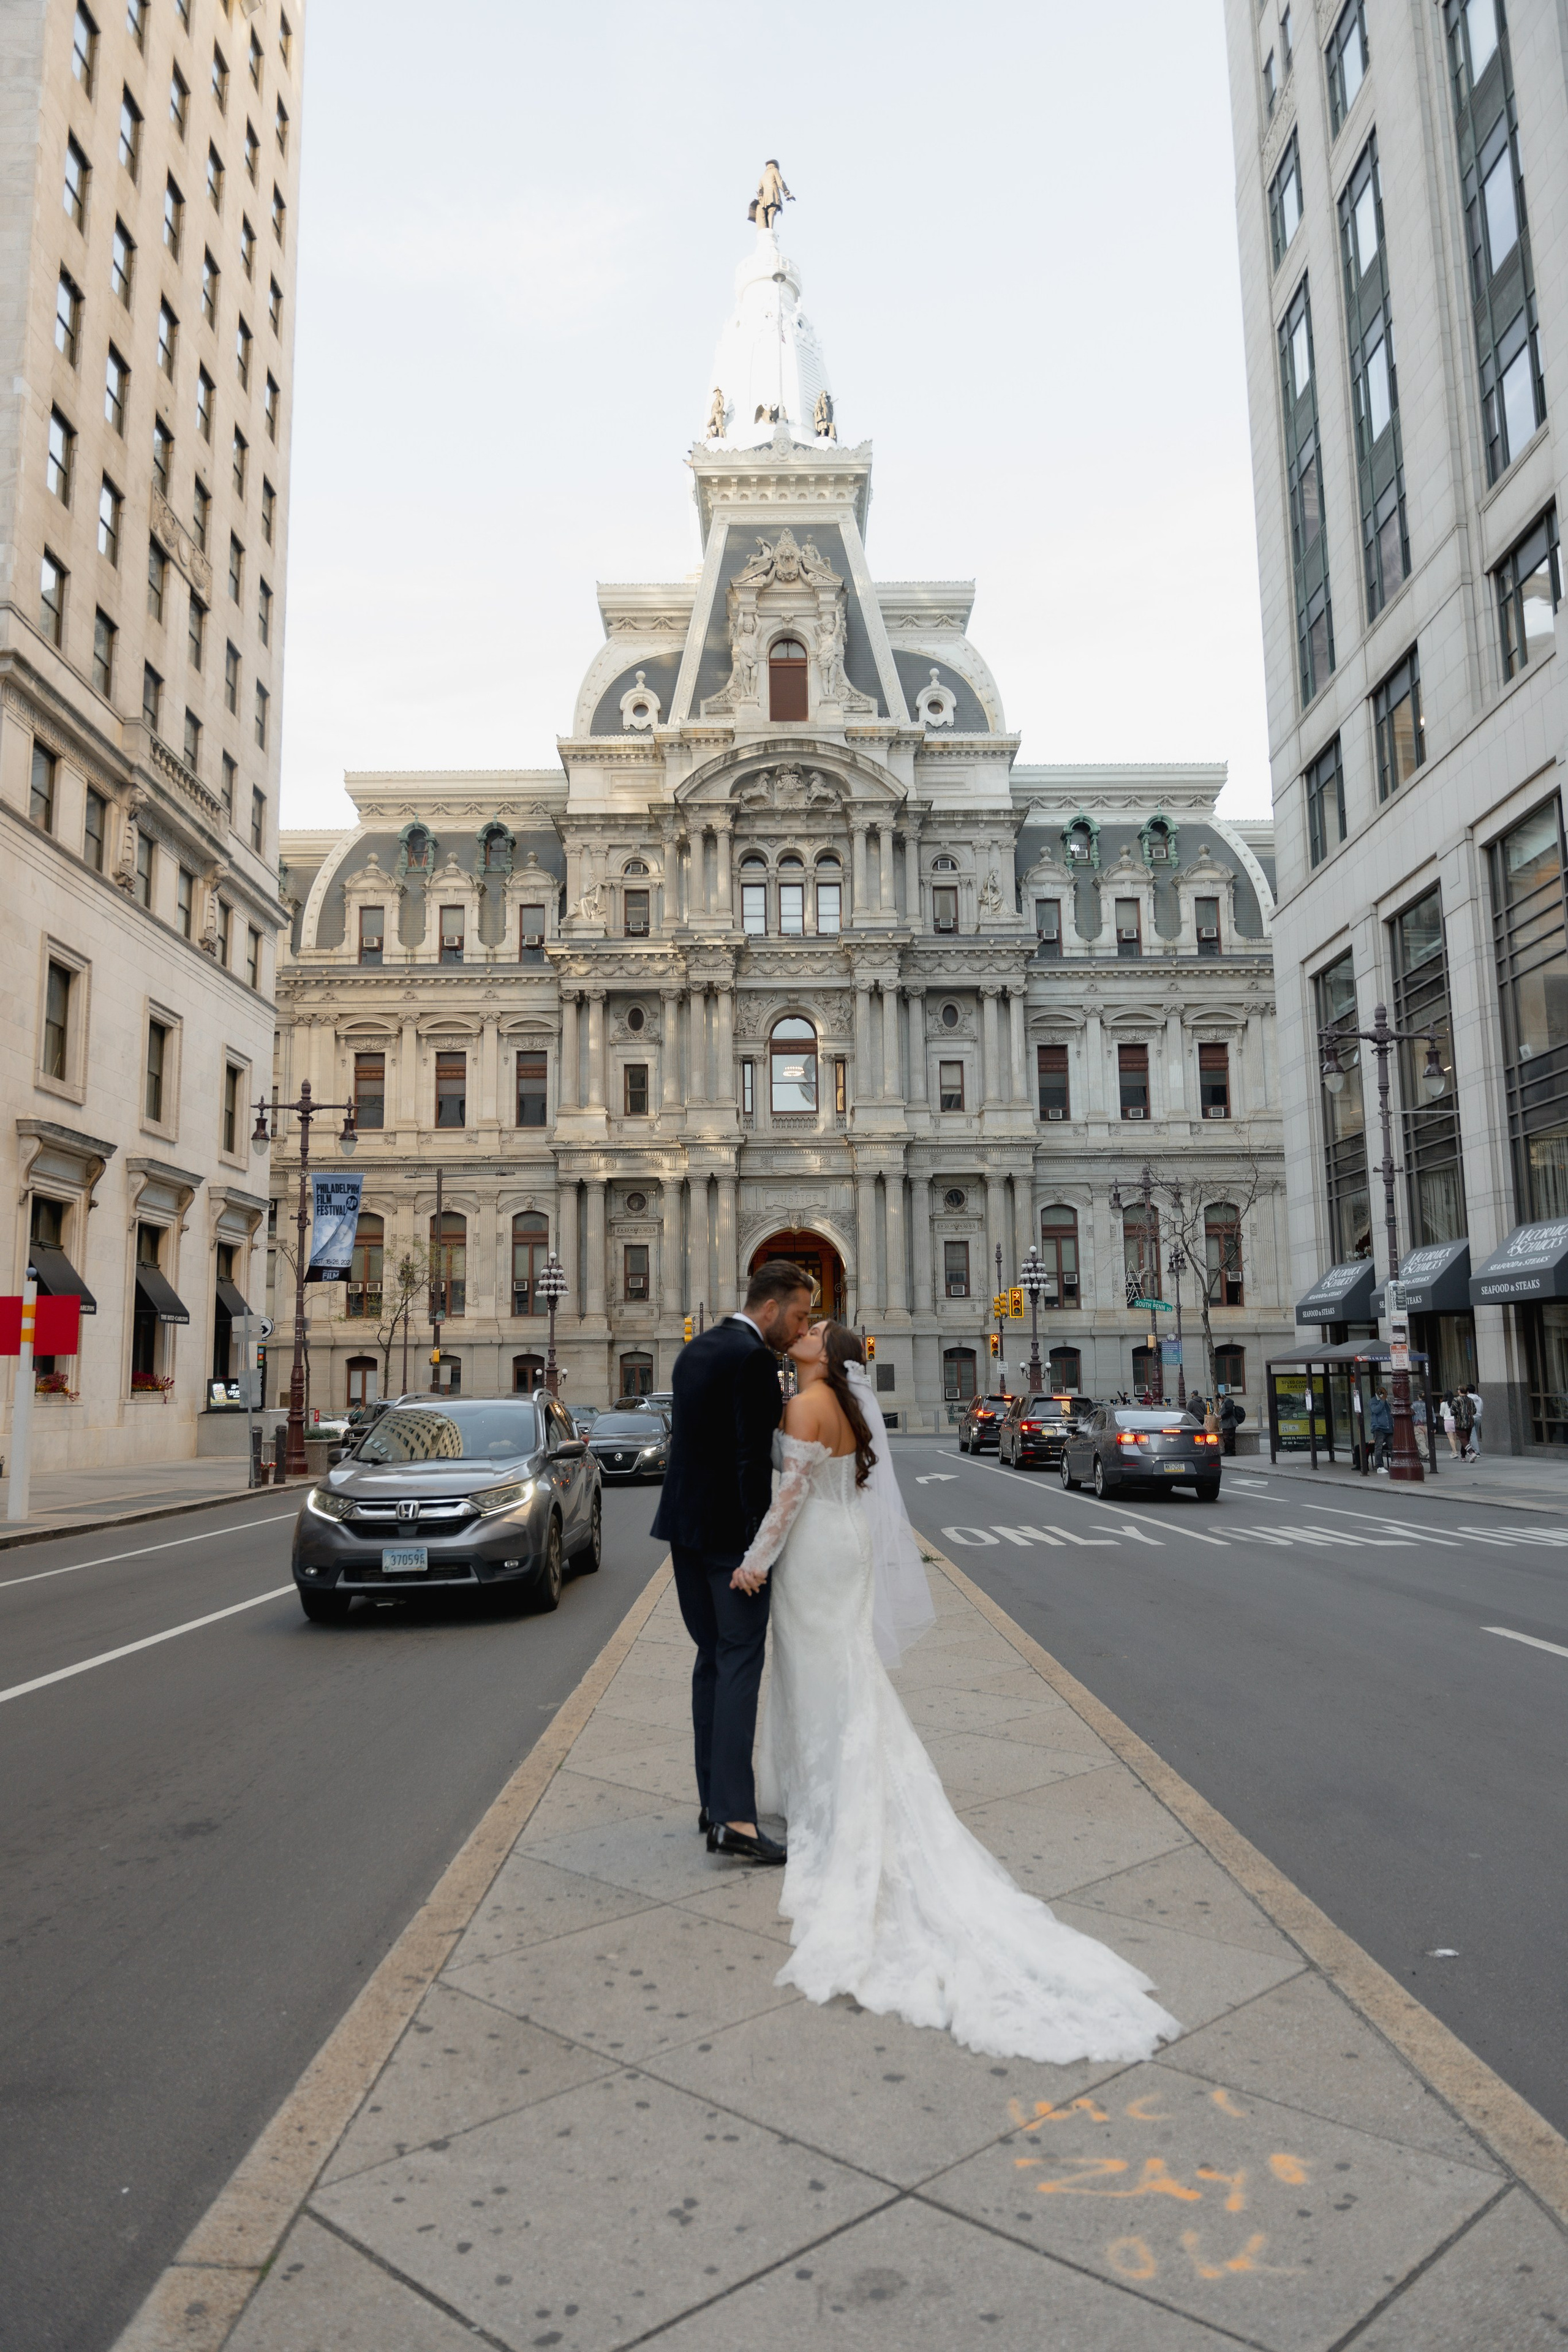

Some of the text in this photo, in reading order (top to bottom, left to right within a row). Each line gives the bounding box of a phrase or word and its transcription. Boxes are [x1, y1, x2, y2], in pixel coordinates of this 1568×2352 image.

[316, 1194, 332, 1205] FILM
[317, 1205, 347, 1216] FESTIVAL
[1480, 1283, 1509, 1295] SEAFOOD
[1515, 1279, 1540, 1291] STEAKS
[1406, 1295, 1422, 1305] TEAKS
[1302, 1310, 1319, 1318] SEAFOOD
[1322, 1307, 1335, 1316] STEAKS
[941, 1526, 1166, 1546] ONLY
[1207, 1526, 1464, 1546] ONLY
